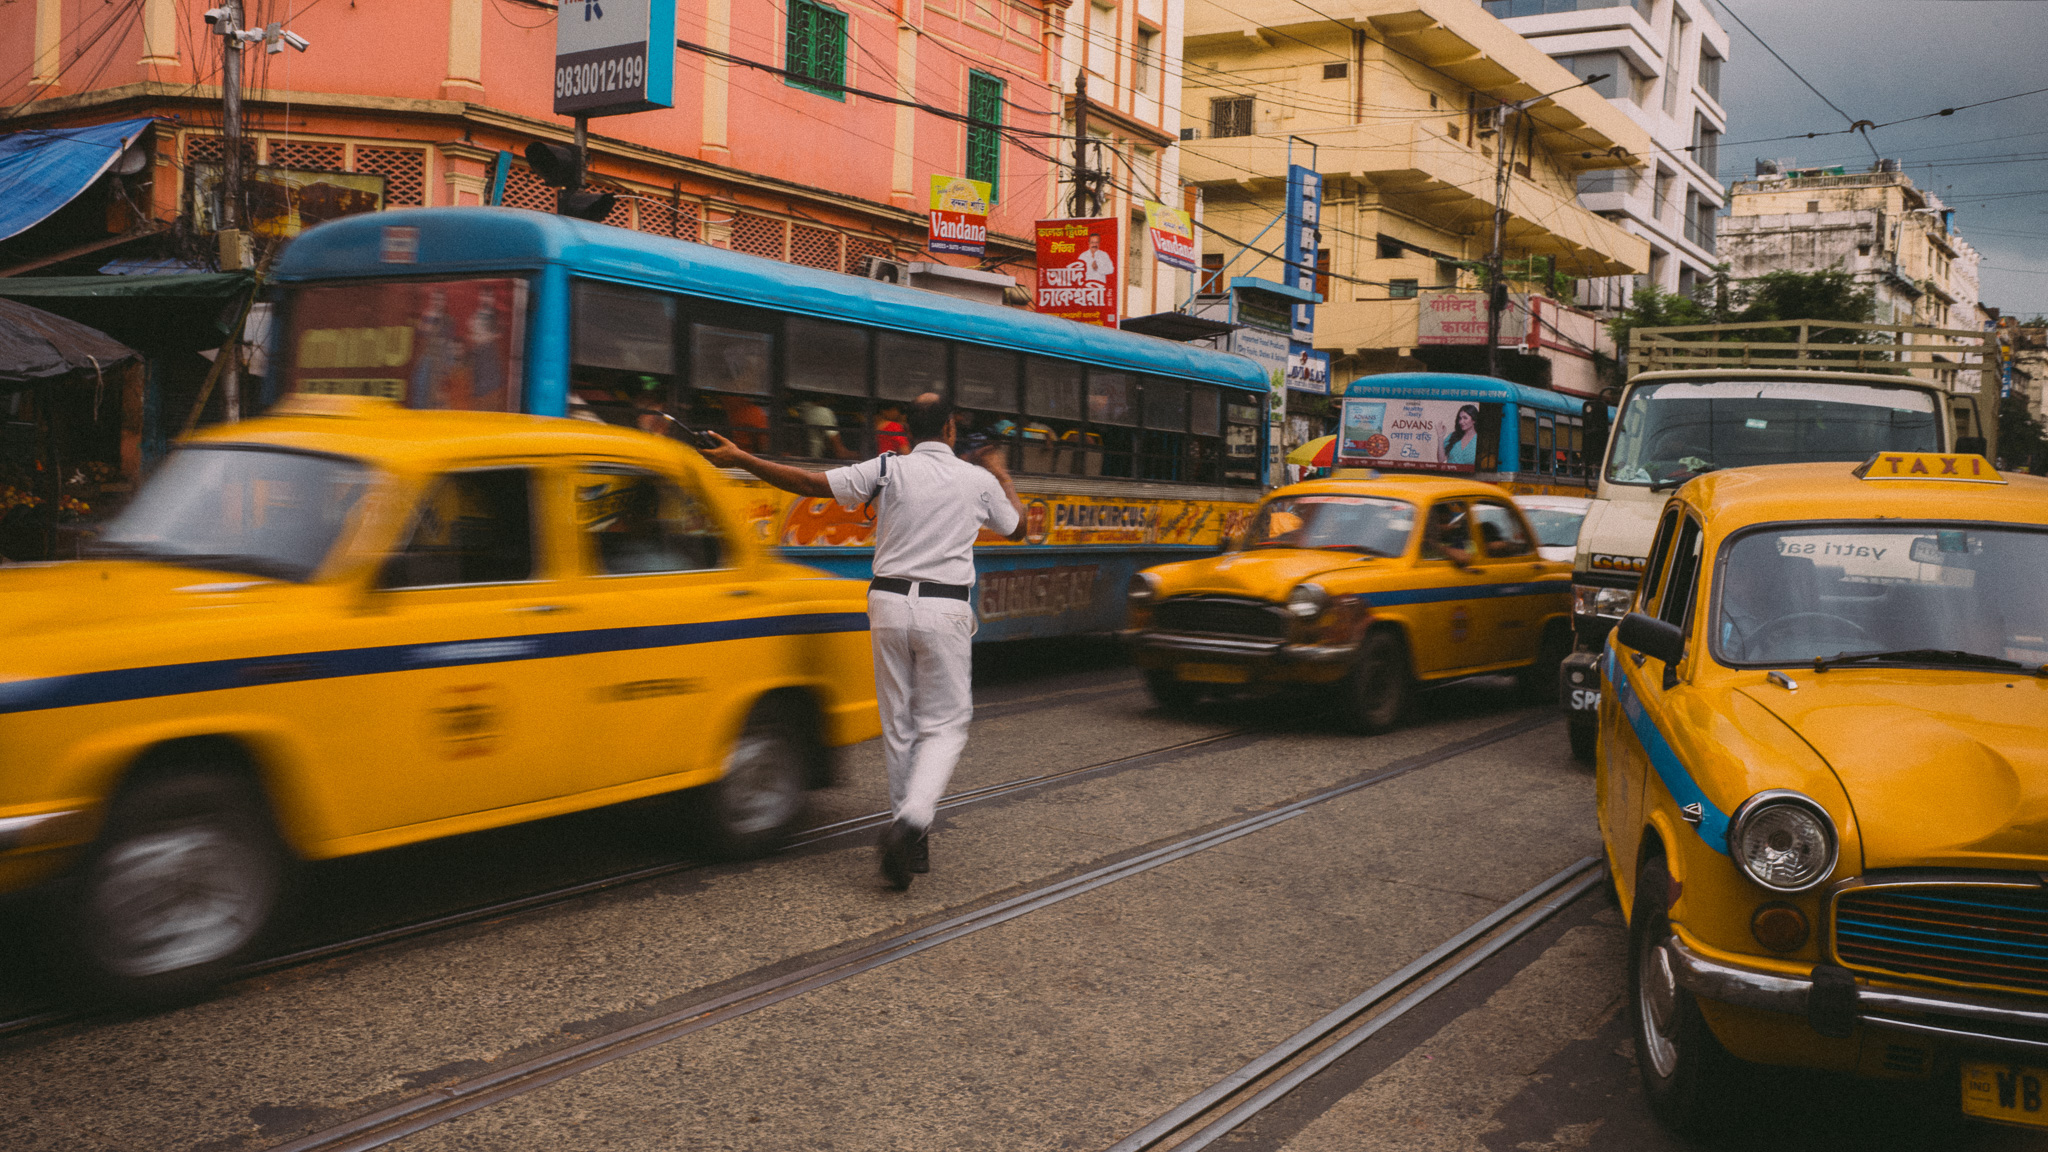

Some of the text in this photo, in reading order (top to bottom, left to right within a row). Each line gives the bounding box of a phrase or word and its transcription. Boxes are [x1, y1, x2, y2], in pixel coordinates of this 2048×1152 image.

[556, 55, 643, 98] 9830012199
[931, 211, 986, 242] Vandana
[1151, 229, 1195, 260] Vandana
[1046, 261, 1085, 286] আদি
[1440, 315, 1489, 334] कार्याल
[1391, 419, 1433, 430] ADVANS
[1401, 443, 1412, 458] 5
[1885, 457, 1980, 475] TAXI
[1997, 1069, 2042, 1112] WB
